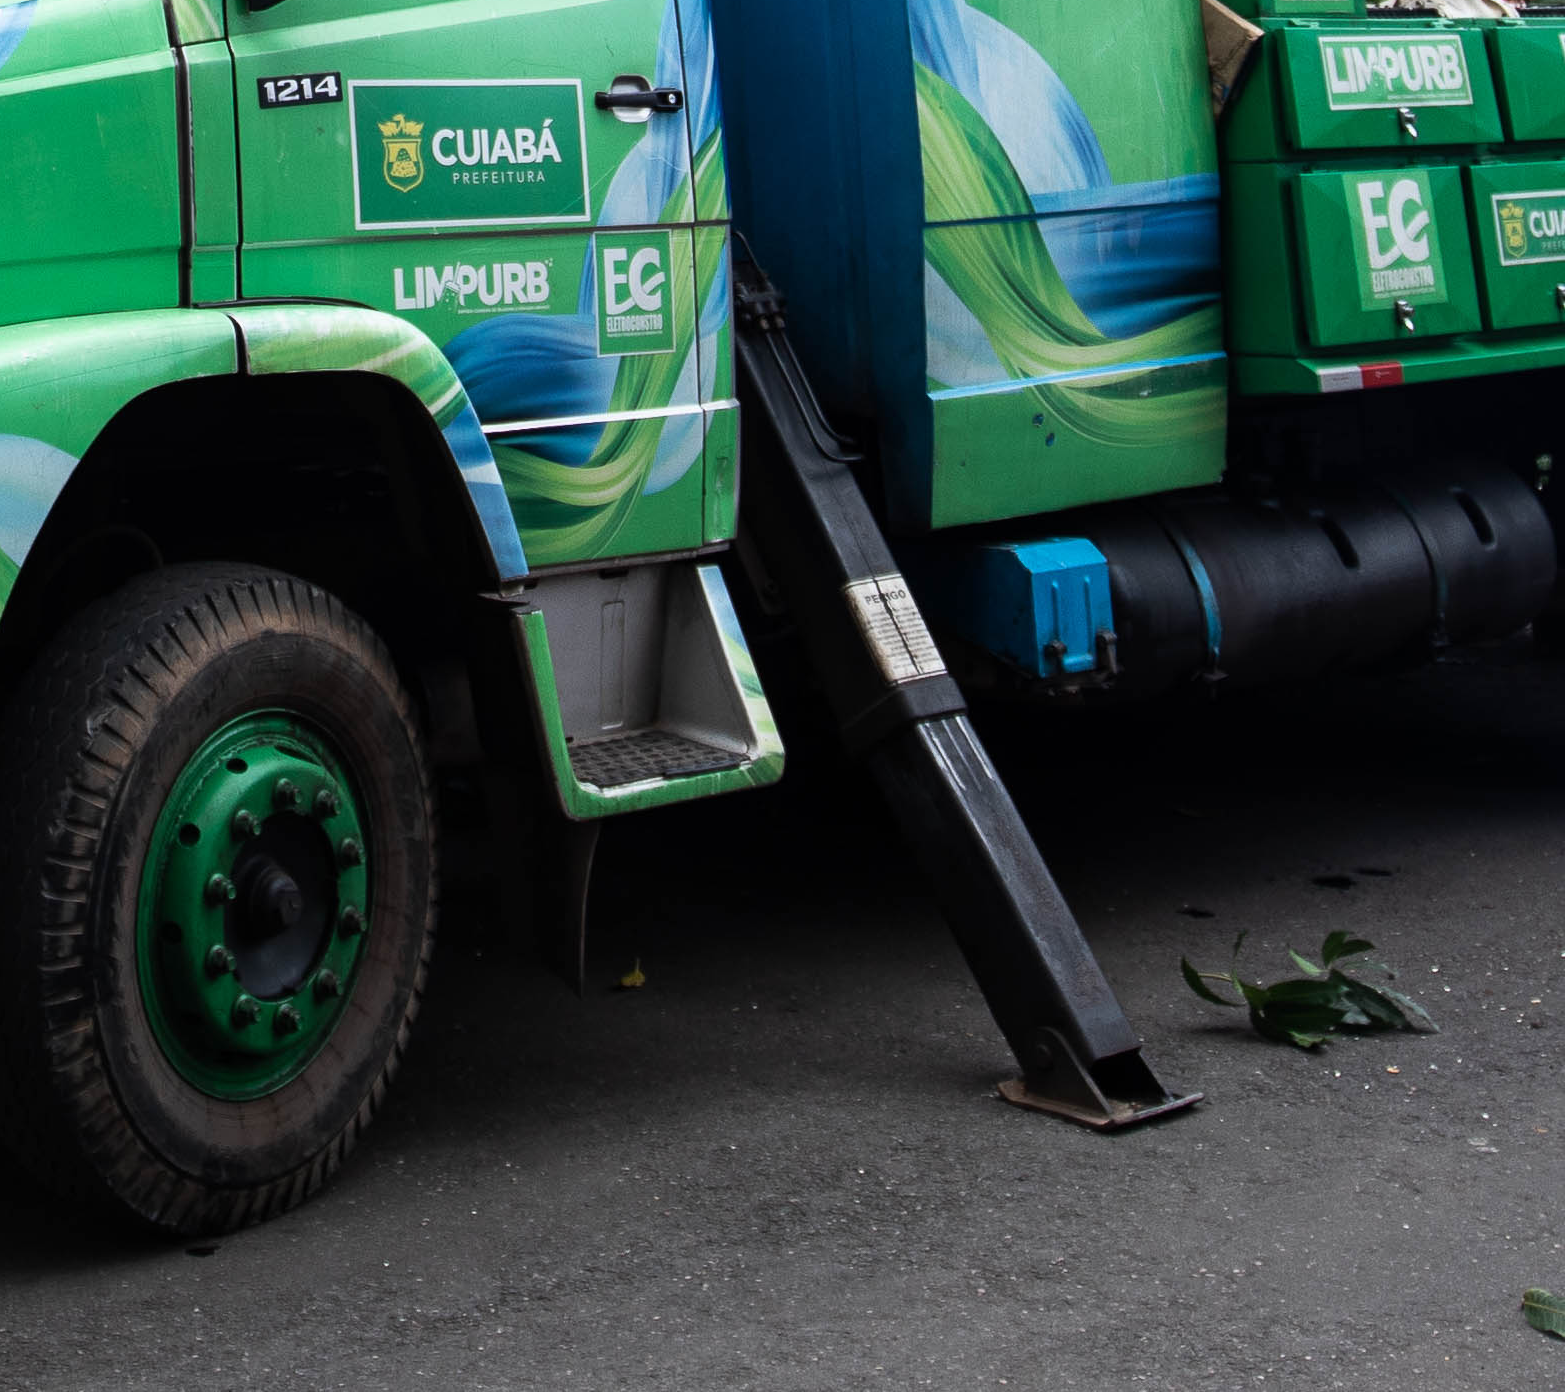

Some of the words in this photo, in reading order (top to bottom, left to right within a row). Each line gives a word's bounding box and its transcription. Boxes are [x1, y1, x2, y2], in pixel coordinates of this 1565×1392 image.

[1325, 43, 1464, 94] LIMPURB
[263, 74, 338, 104] 1214
[432, 118, 562, 166] CUIABÁ
[452, 170, 546, 185] PREFEITURA
[394, 261, 550, 310] LIMPURB
[864, 589, 907, 605] PEIGO
